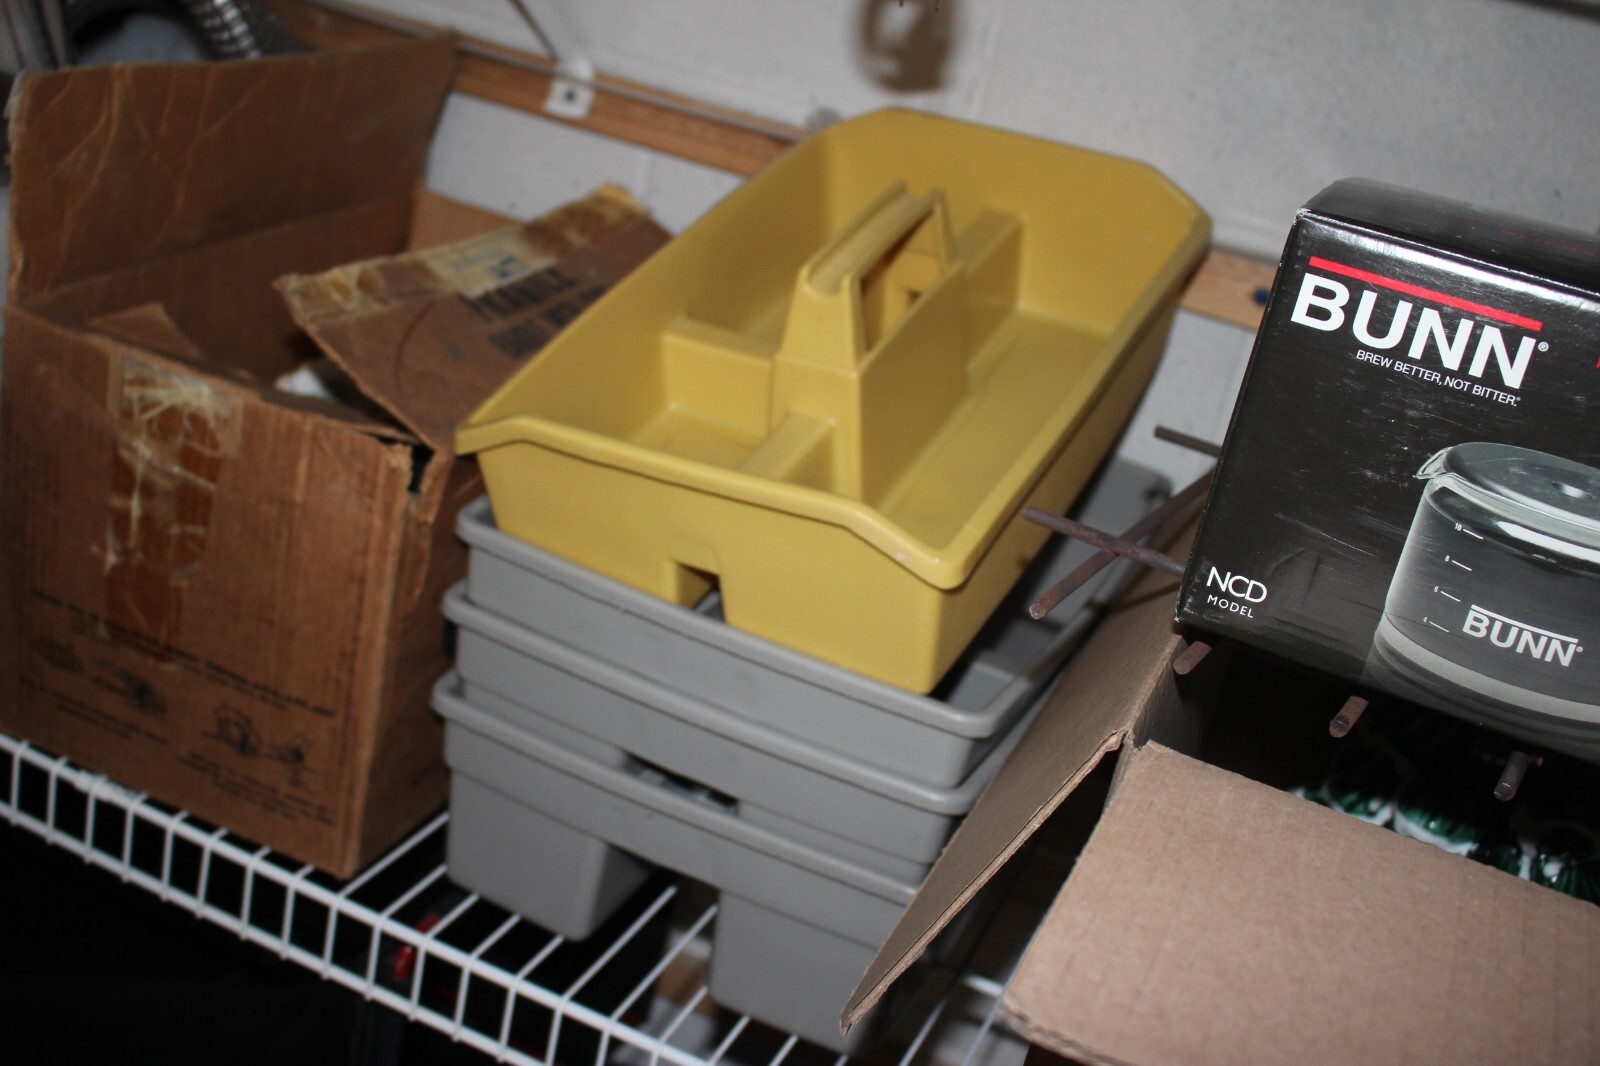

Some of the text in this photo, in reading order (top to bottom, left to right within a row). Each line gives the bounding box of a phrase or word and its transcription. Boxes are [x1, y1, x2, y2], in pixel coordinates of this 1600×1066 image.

[1355, 349, 1393, 368] BREW
[1393, 360, 1442, 386] BETTER,
[1444, 375, 1472, 392] NOT
[1454, 522, 1462, 531] 10
[1444, 554, 1450, 562] 8
[1206, 565, 1268, 603] NCD
[1206, 594, 1254, 619] MODEL
